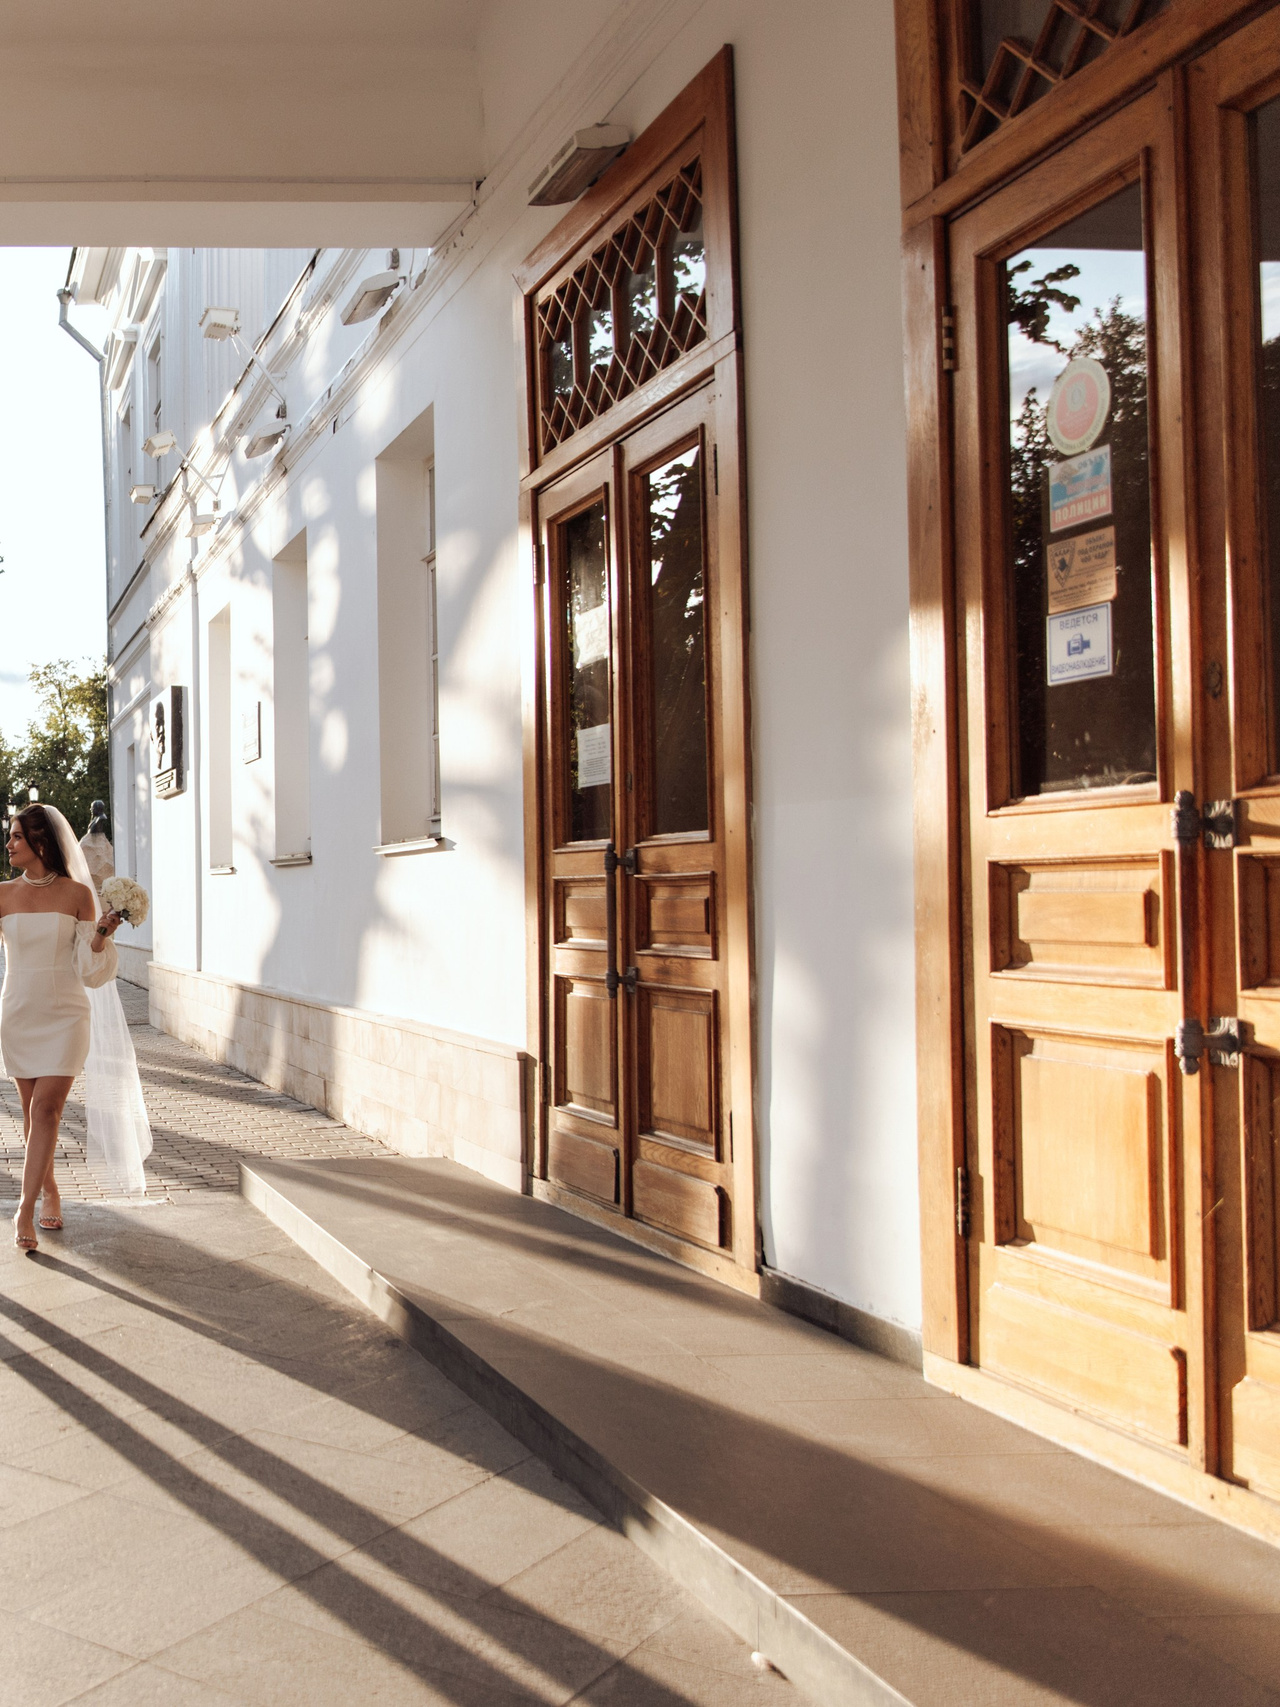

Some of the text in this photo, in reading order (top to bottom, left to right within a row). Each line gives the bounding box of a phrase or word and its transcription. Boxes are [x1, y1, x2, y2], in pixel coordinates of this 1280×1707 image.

[1055, 493, 1107, 523] ПОЛИЦИИ
[1060, 613, 1098, 630] ВЕДЕТСЯ
[1051, 656, 1106, 674] ВИДЕОНАБЛЮДЕНИЕ
